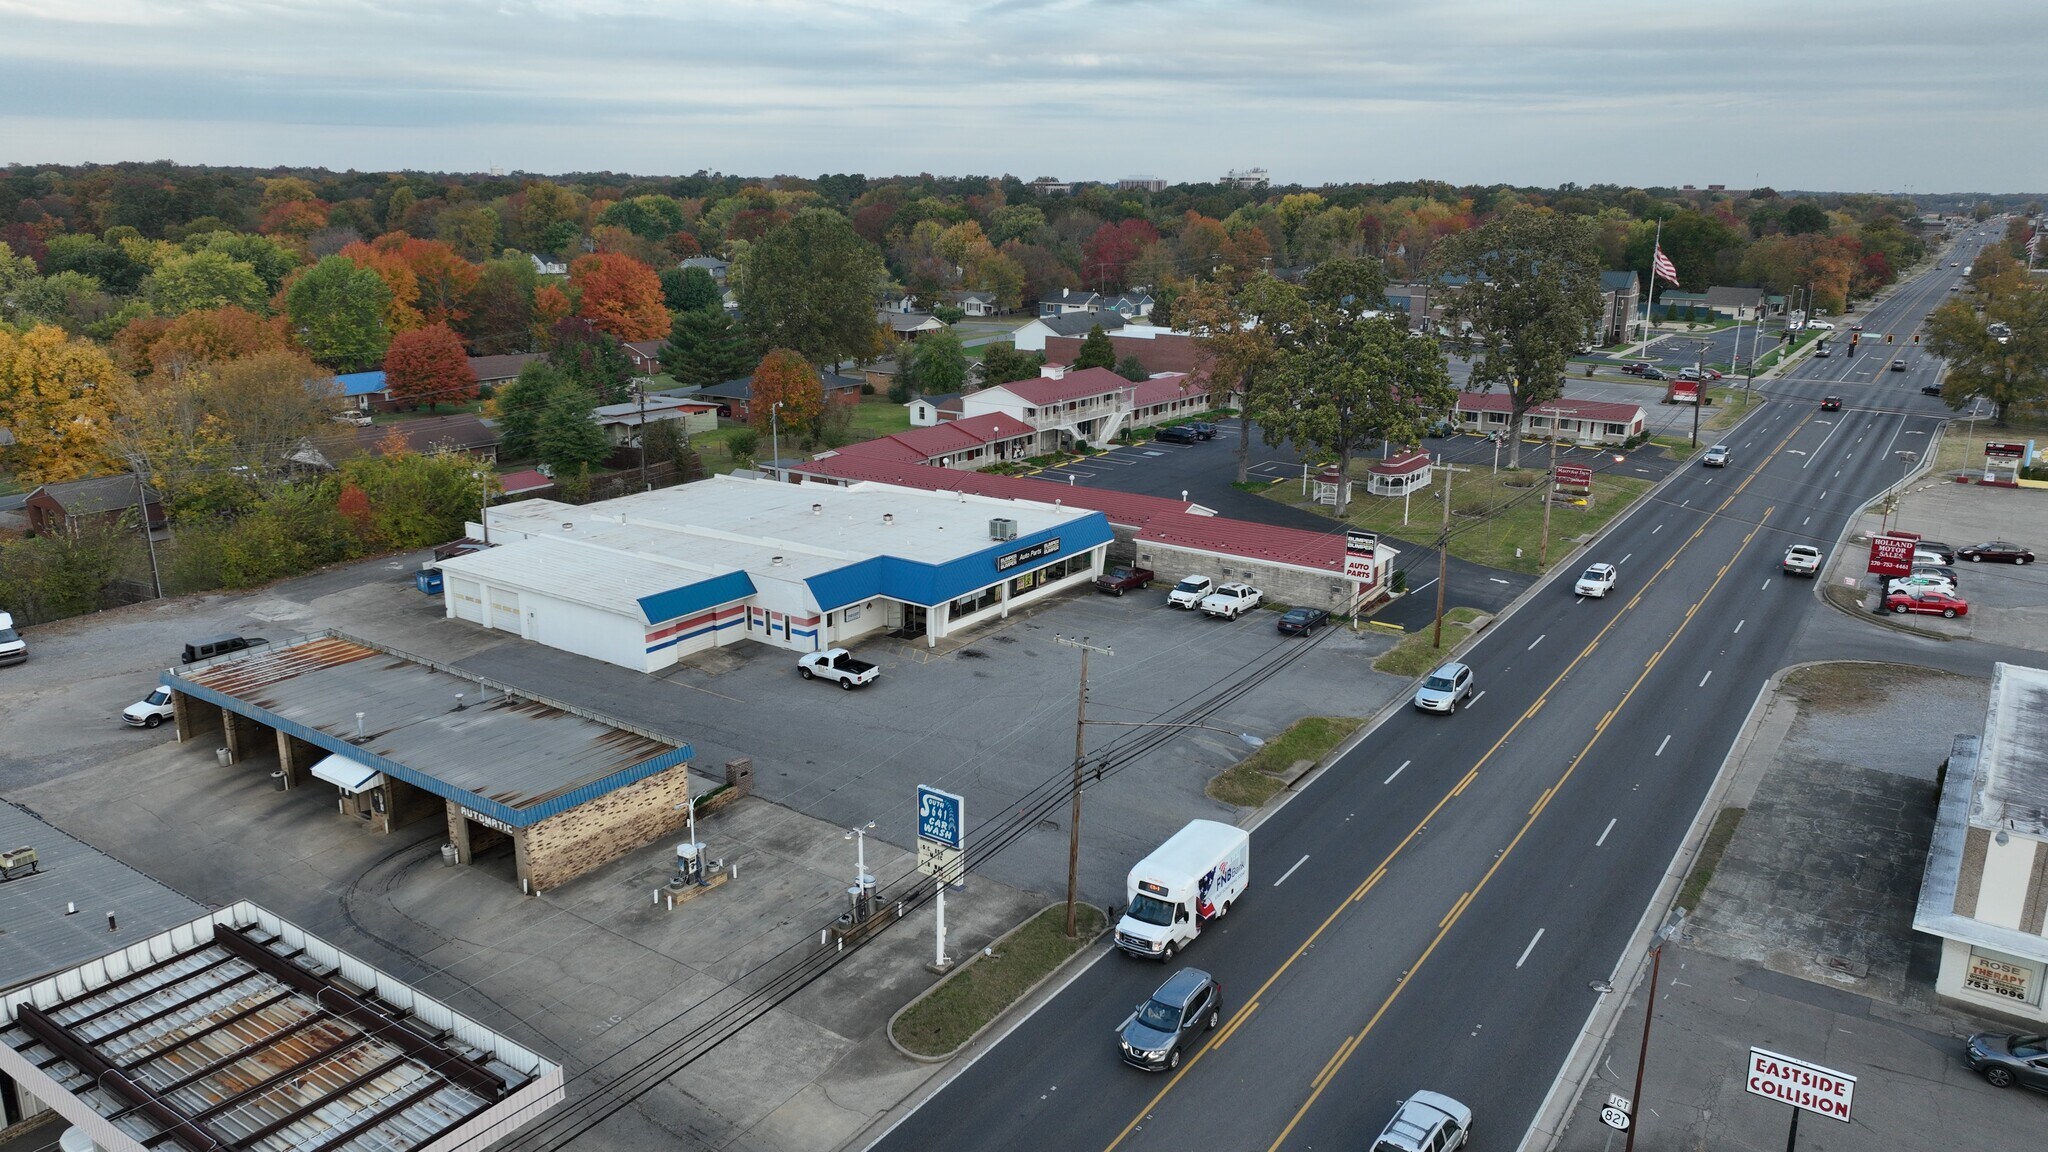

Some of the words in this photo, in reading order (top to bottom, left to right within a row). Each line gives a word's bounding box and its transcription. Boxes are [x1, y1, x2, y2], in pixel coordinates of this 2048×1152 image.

[1875, 539, 1913, 548] HOLLAND
[1879, 546, 1906, 554] MOTOR
[1030, 548, 1042, 557] Parts
[1347, 570, 1370, 578] PARTS
[461, 806, 513, 834] AUTOMATIC
[932, 807, 947, 820] 641
[924, 823, 952, 839] WASH
[929, 818, 947, 830] CAR
[1217, 868, 1231, 891] FNB
[1980, 960, 2021, 975] ROSE
[1972, 966, 2025, 985] THERAPY
[1967, 980, 2024, 1000] 753-1096
[1756, 1058, 1846, 1096] EASTSIDE
[1610, 1097, 1629, 1109] JCT
[1750, 1077, 1848, 1118] COLLISION
[1605, 1110, 1625, 1126] 821
